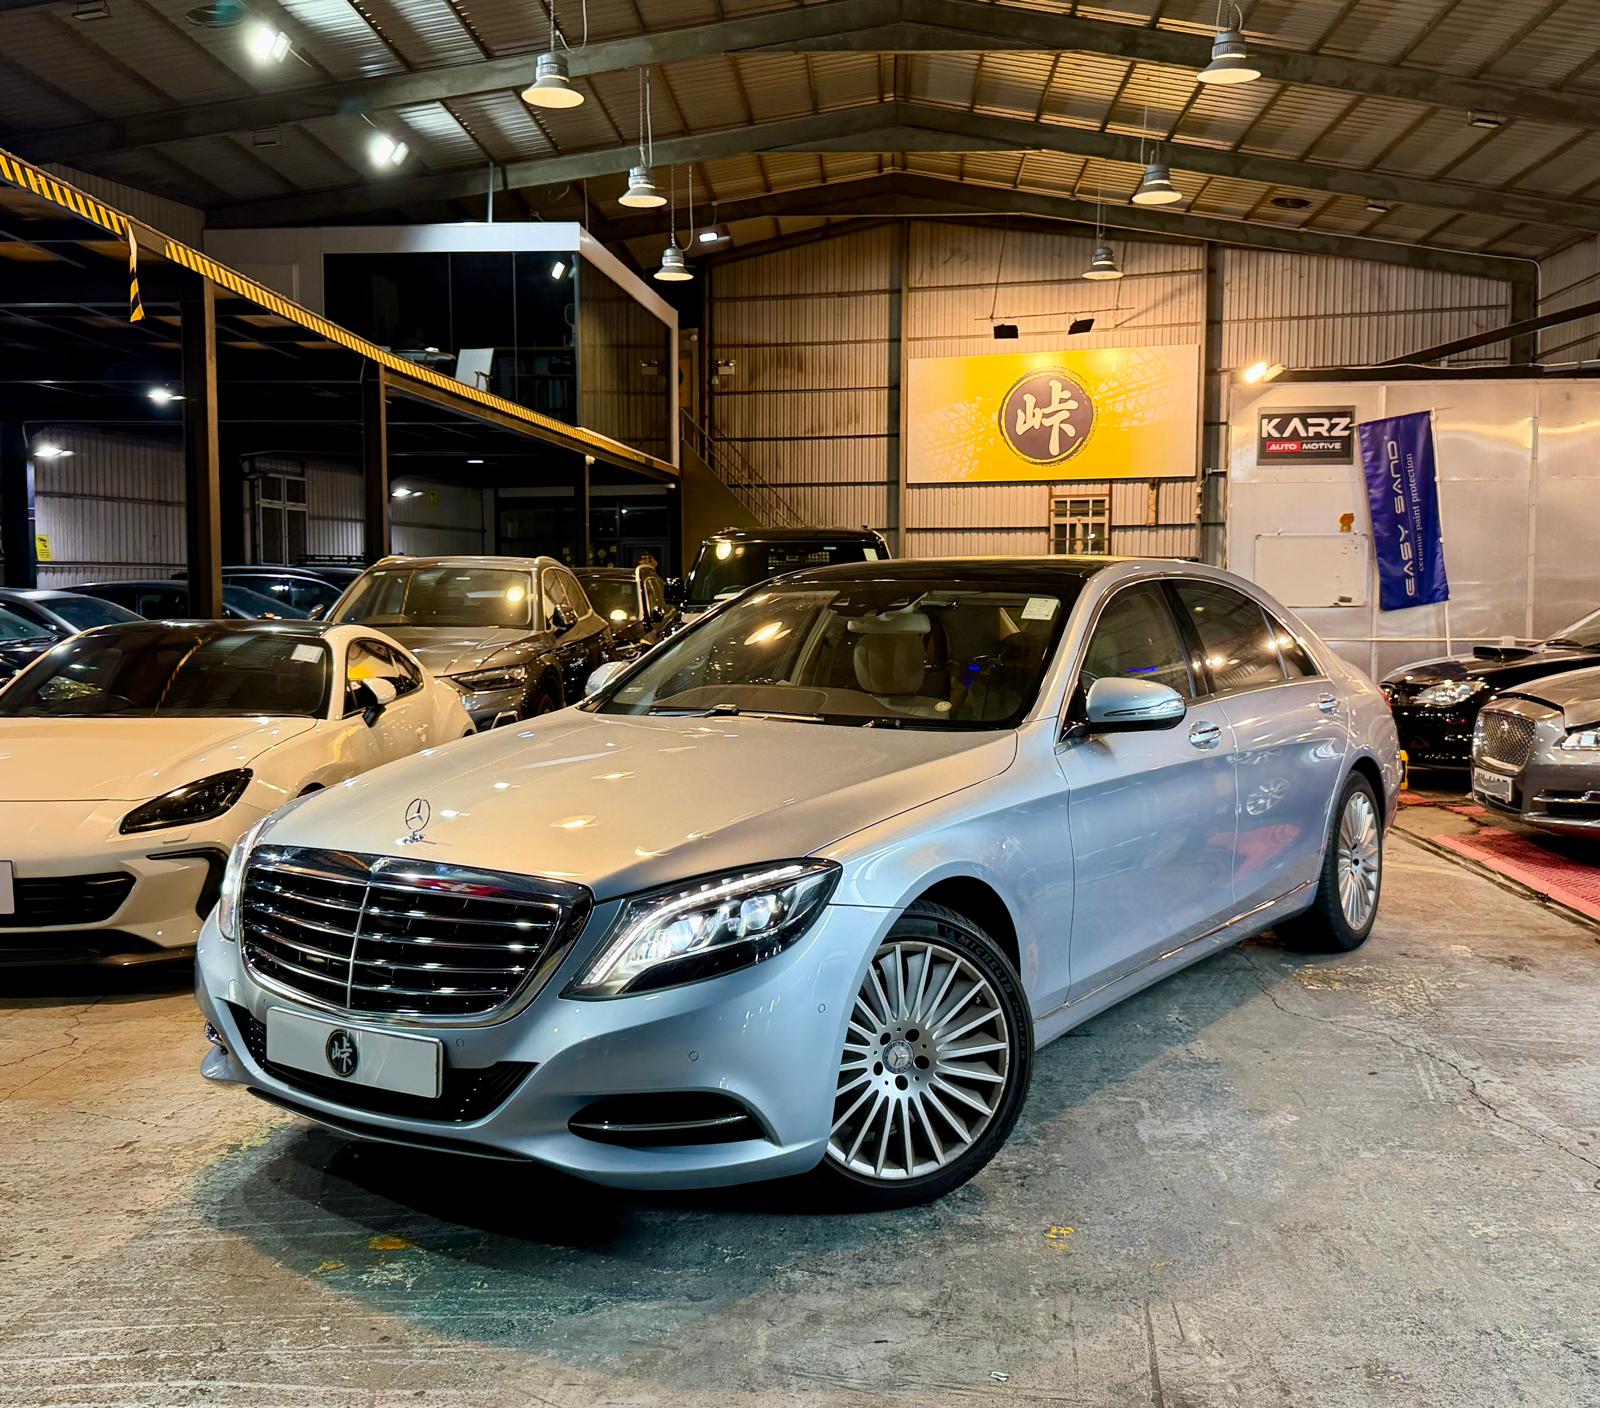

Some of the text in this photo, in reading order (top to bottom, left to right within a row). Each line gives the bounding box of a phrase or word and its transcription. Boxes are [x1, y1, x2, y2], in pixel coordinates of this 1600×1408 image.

[1016, 379, 1078, 456] 峠
[1261, 417, 1351, 438] KARZ
[1301, 442, 1342, 450] MOTIVE
[1387, 440, 1415, 596] EASY SAND
[1405, 453, 1425, 571] ceramic paint protection
[957, 934, 1014, 993] MICHELIN
[331, 1036, 353, 1073] 峠
